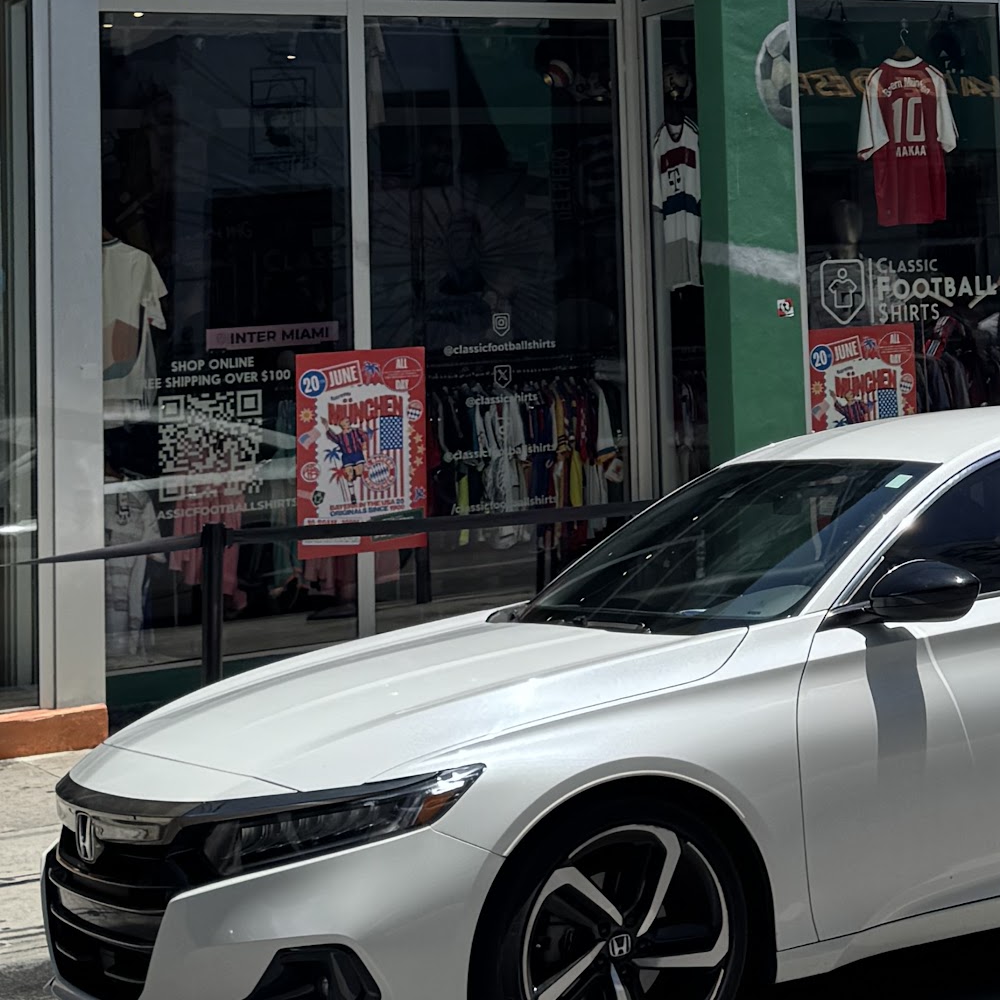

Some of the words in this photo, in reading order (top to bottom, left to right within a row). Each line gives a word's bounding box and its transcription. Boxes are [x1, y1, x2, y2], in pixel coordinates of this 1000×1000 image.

[892, 97, 926, 143] 10
[876, 257, 938, 274] CLASSIC
[876, 275, 998, 301] FOOTBALL
[878, 303, 940, 324] SHIRTS
[230, 331, 277, 345] INTER
[281, 327, 329, 342] MIAMI
[443, 339, 556, 357] @classicfootballshirts
[812, 349, 828, 368] 20
[833, 340, 860, 361] JUNE
[171, 359, 205, 373] SHOP
[208, 356, 255, 371] ONLINE
[142, 377, 162, 390] REE
[165, 374, 222, 389] SHIPPING
[224, 371, 259, 385] OVER
[261, 369, 291, 383] $100
[302, 375, 320, 395] 20
[328, 365, 360, 388] JUNE
[327, 393, 404, 426] MÜNCHEN
[465, 392, 538, 408] @classichirts
